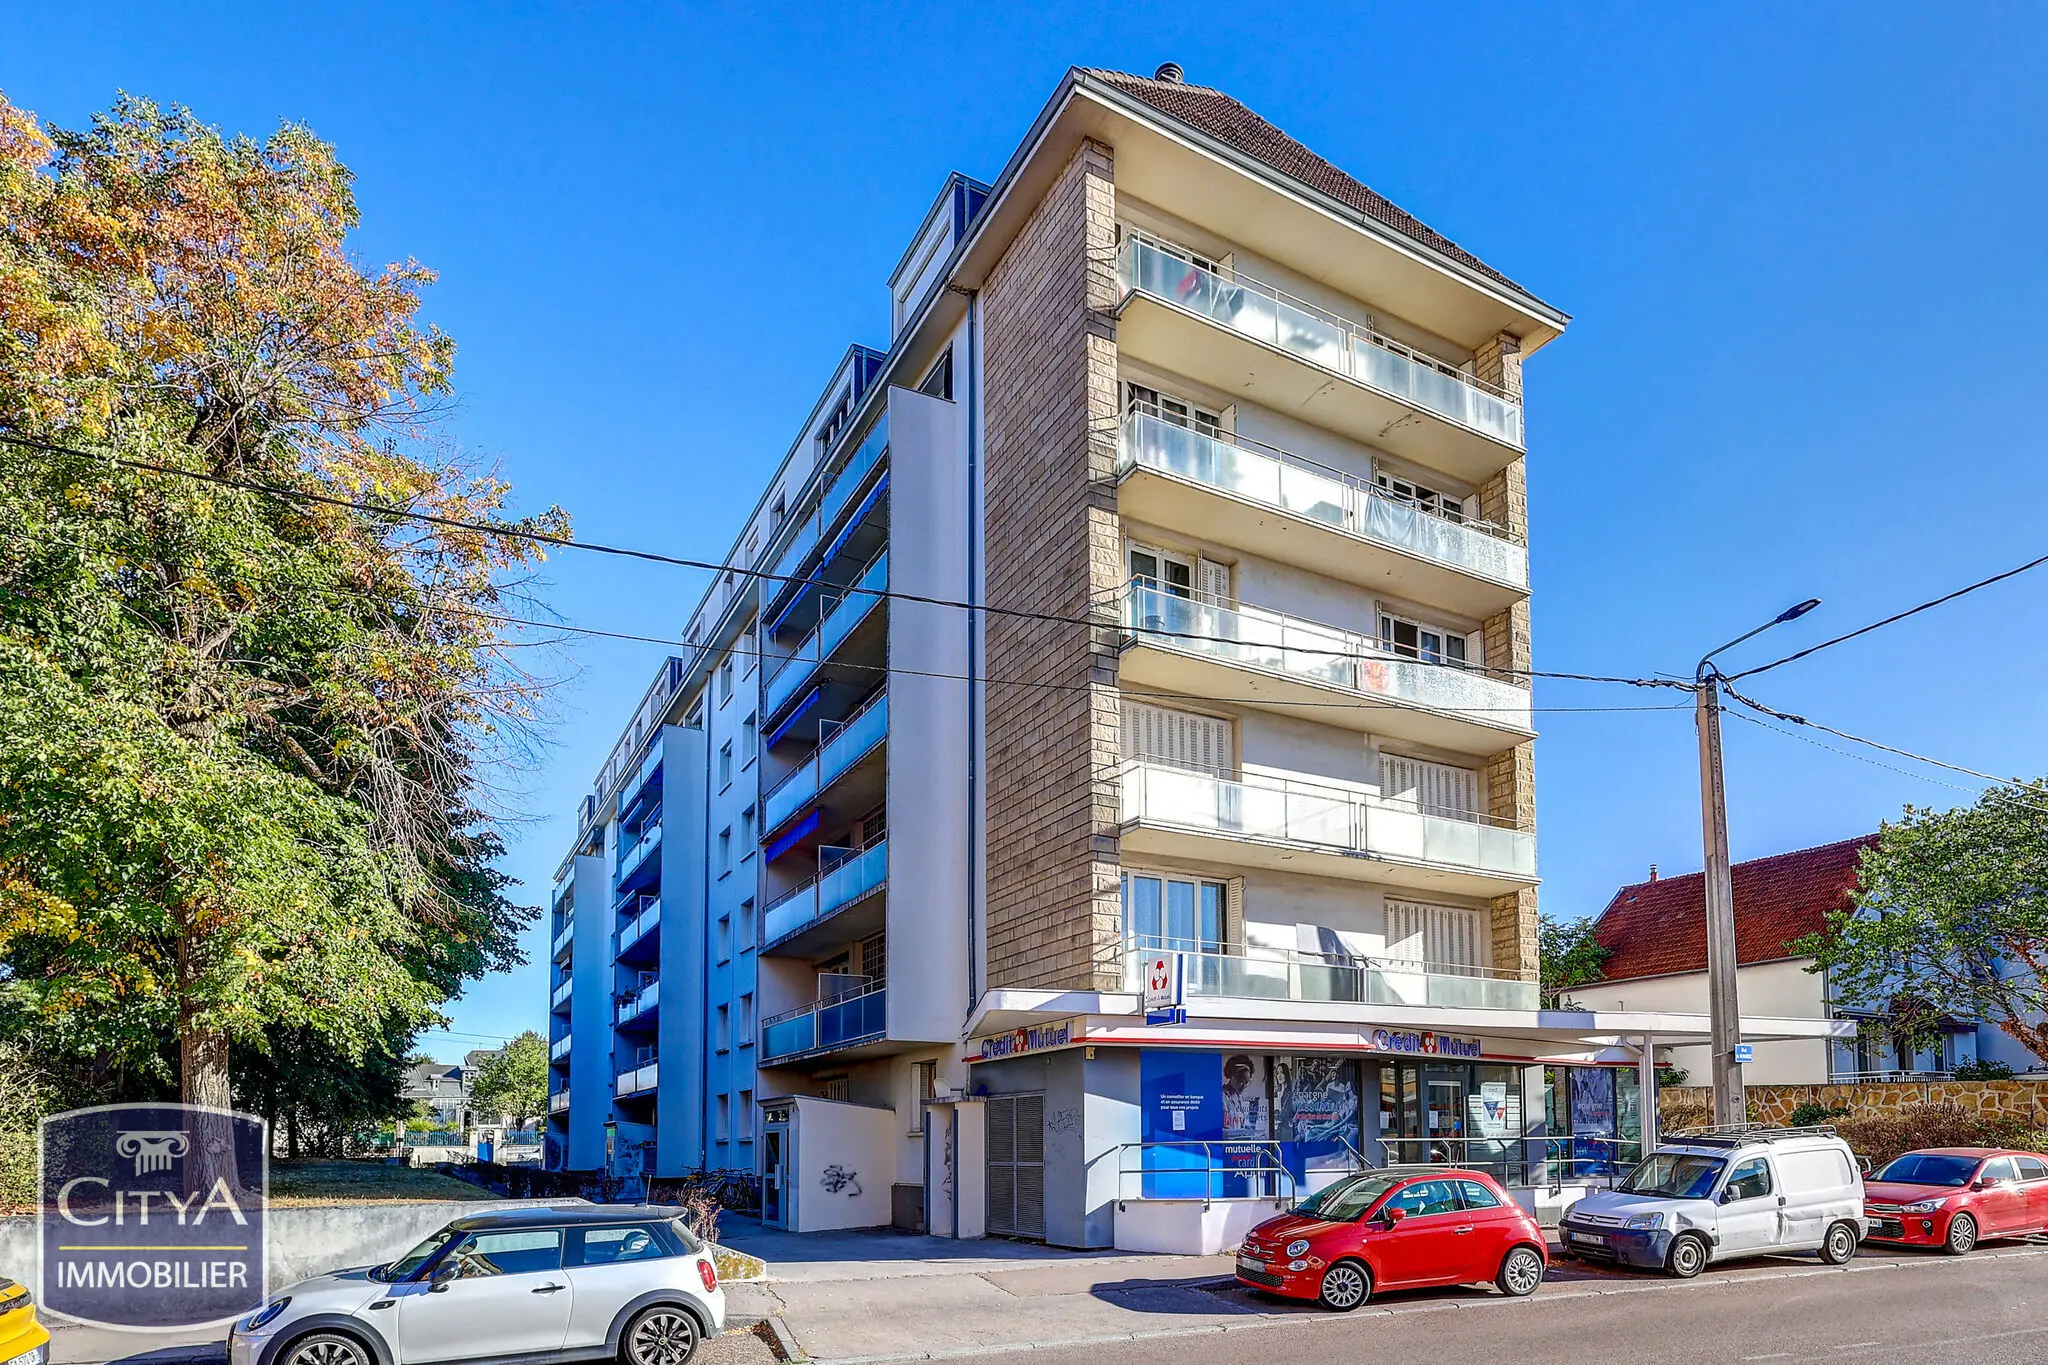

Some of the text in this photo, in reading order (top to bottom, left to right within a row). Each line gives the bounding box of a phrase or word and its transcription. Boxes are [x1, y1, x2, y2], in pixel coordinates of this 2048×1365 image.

[981, 1022, 1069, 1059] Crédit Mutuel
[1377, 1029, 1481, 1057] Crédit Mutuel
[1225, 1143, 1261, 1154] mutuelle
[1237, 1155, 1255, 1168] card
